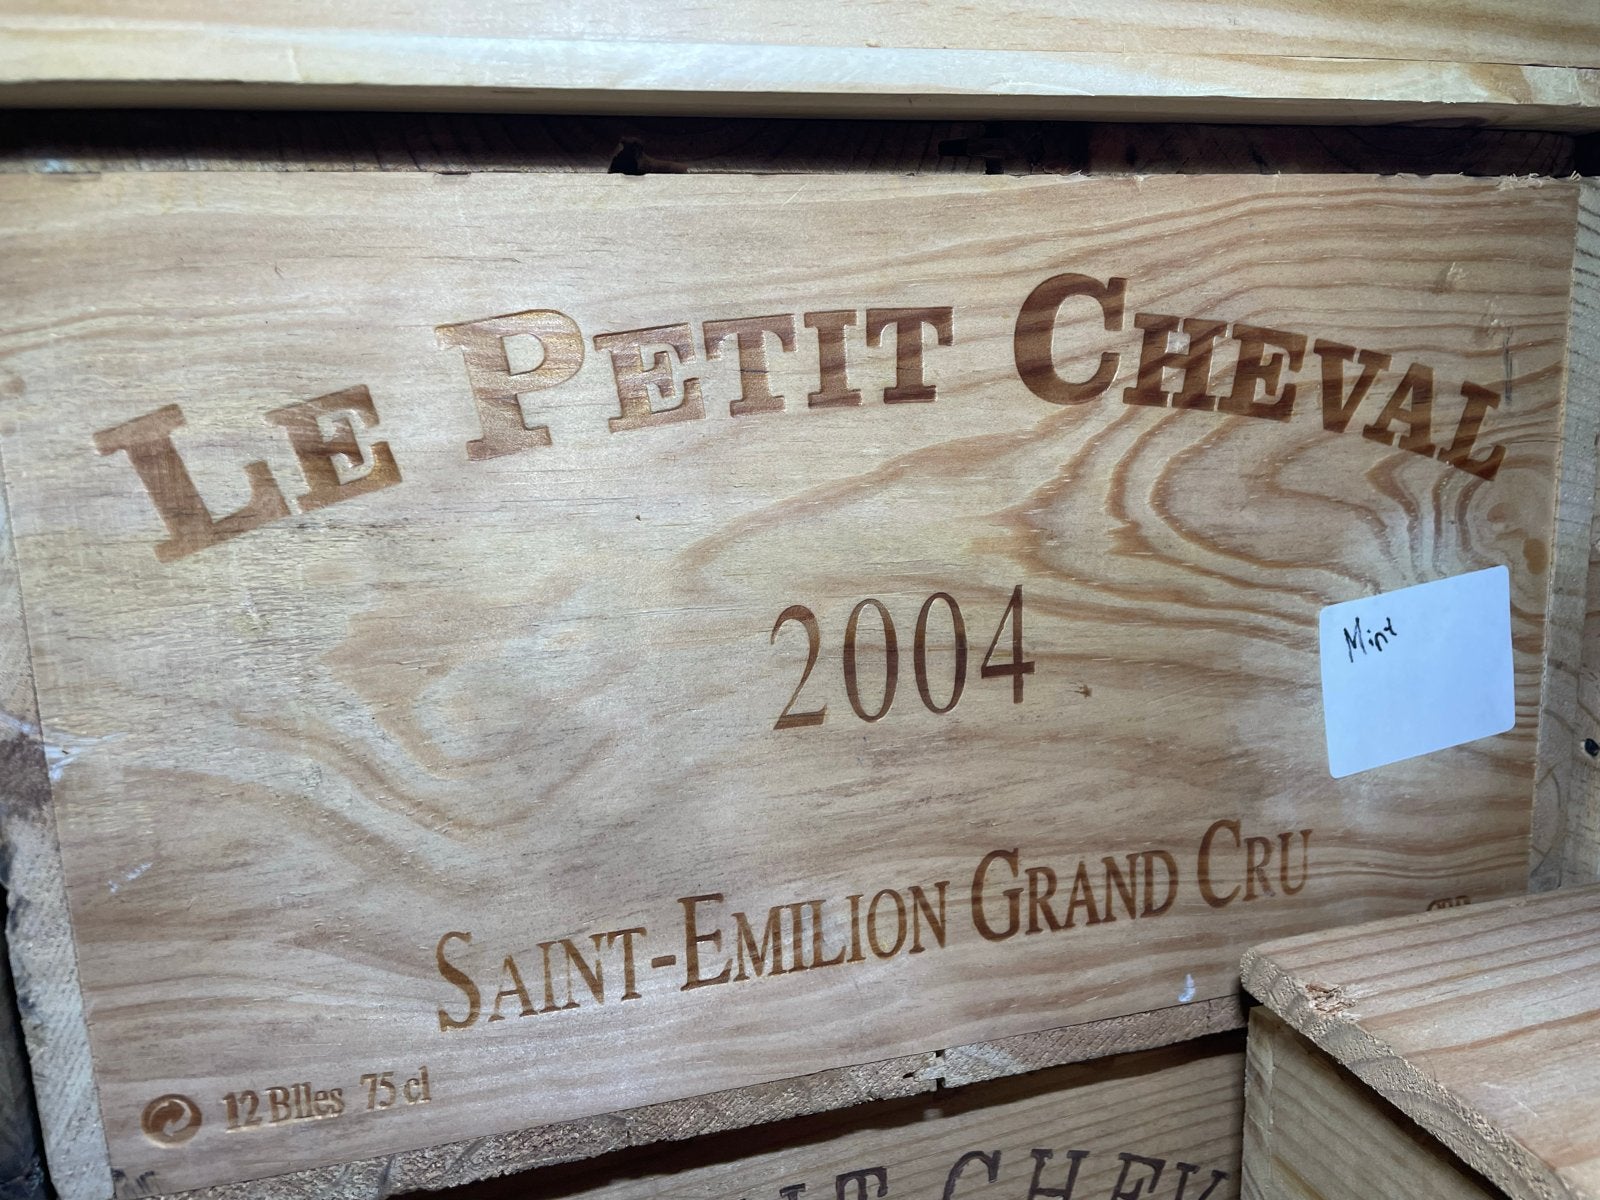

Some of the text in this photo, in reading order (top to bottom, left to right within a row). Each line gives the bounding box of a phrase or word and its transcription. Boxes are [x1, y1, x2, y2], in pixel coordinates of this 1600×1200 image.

[92, 272, 1507, 564] LE PETIT CHEVAL
[770, 584, 1036, 730] 2004
[435, 819, 1314, 1032] SAINT-EMILION GRAND CRU
[222, 1065, 433, 1133] 12 Blles 75 cl
